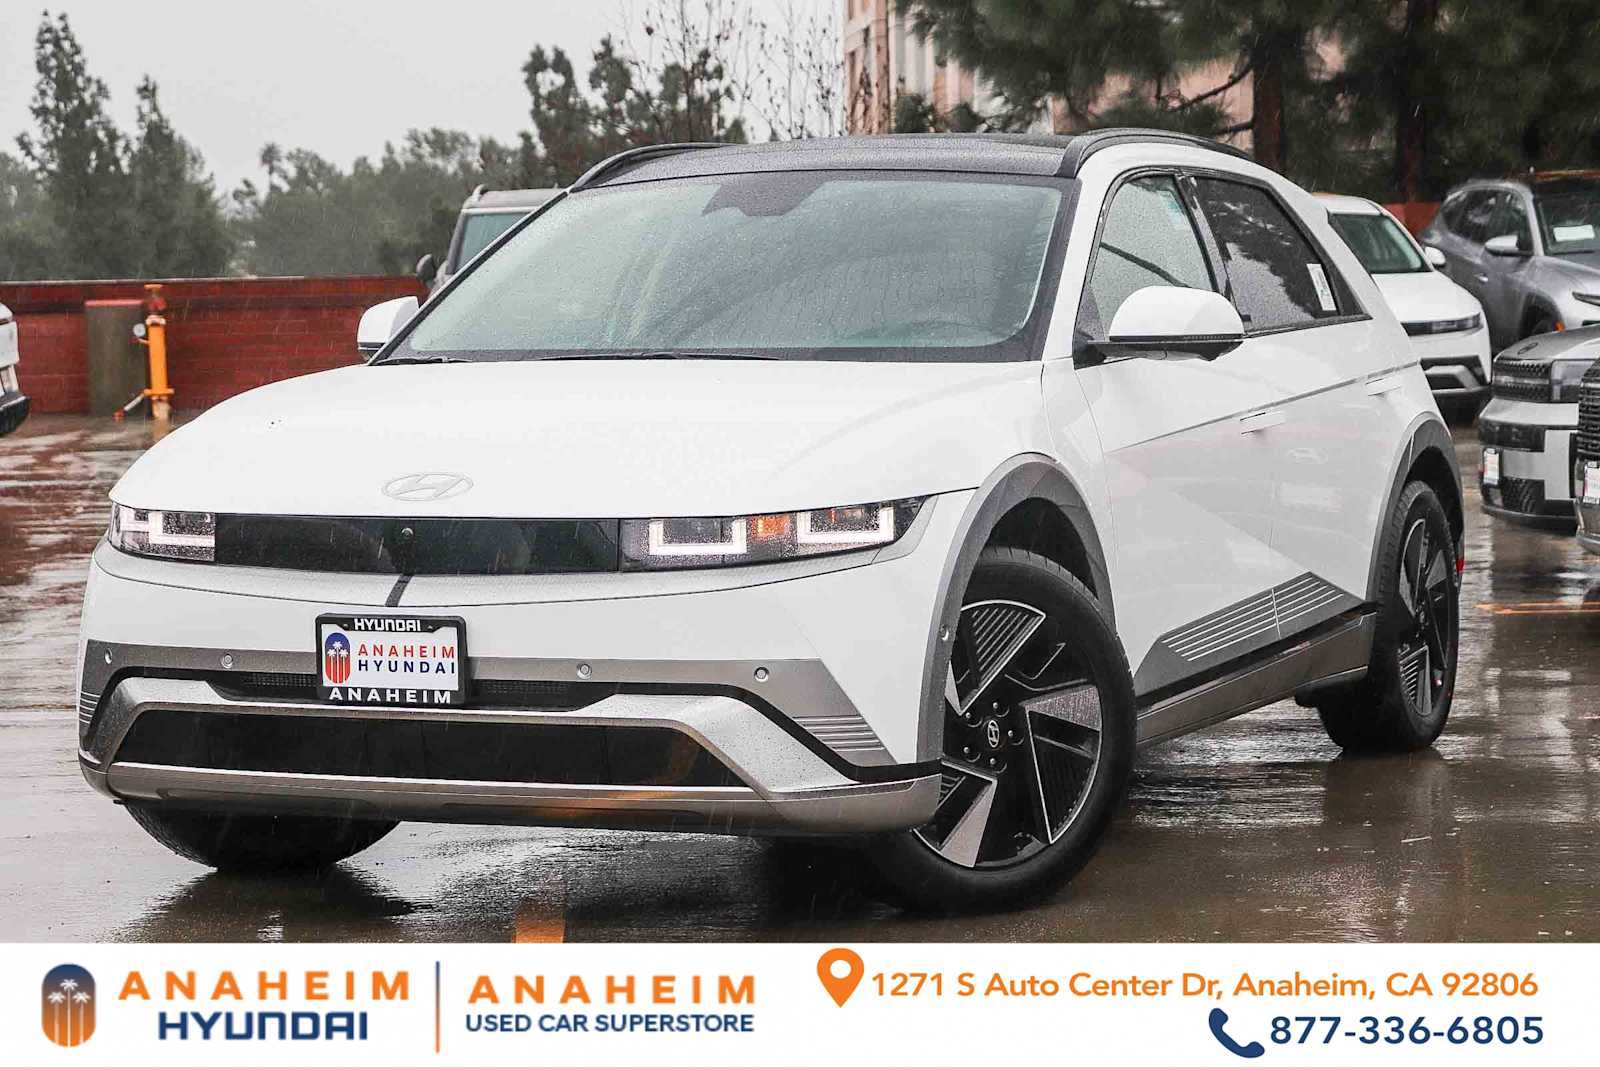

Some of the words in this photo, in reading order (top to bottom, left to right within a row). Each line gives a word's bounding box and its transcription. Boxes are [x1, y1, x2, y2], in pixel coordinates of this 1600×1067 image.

[354, 618, 421, 632] HYUNDAI
[357, 643, 455, 659] ANAHEIM
[358, 659, 455, 674] HYUNDAI
[329, 687, 451, 704] ANAHEIM
